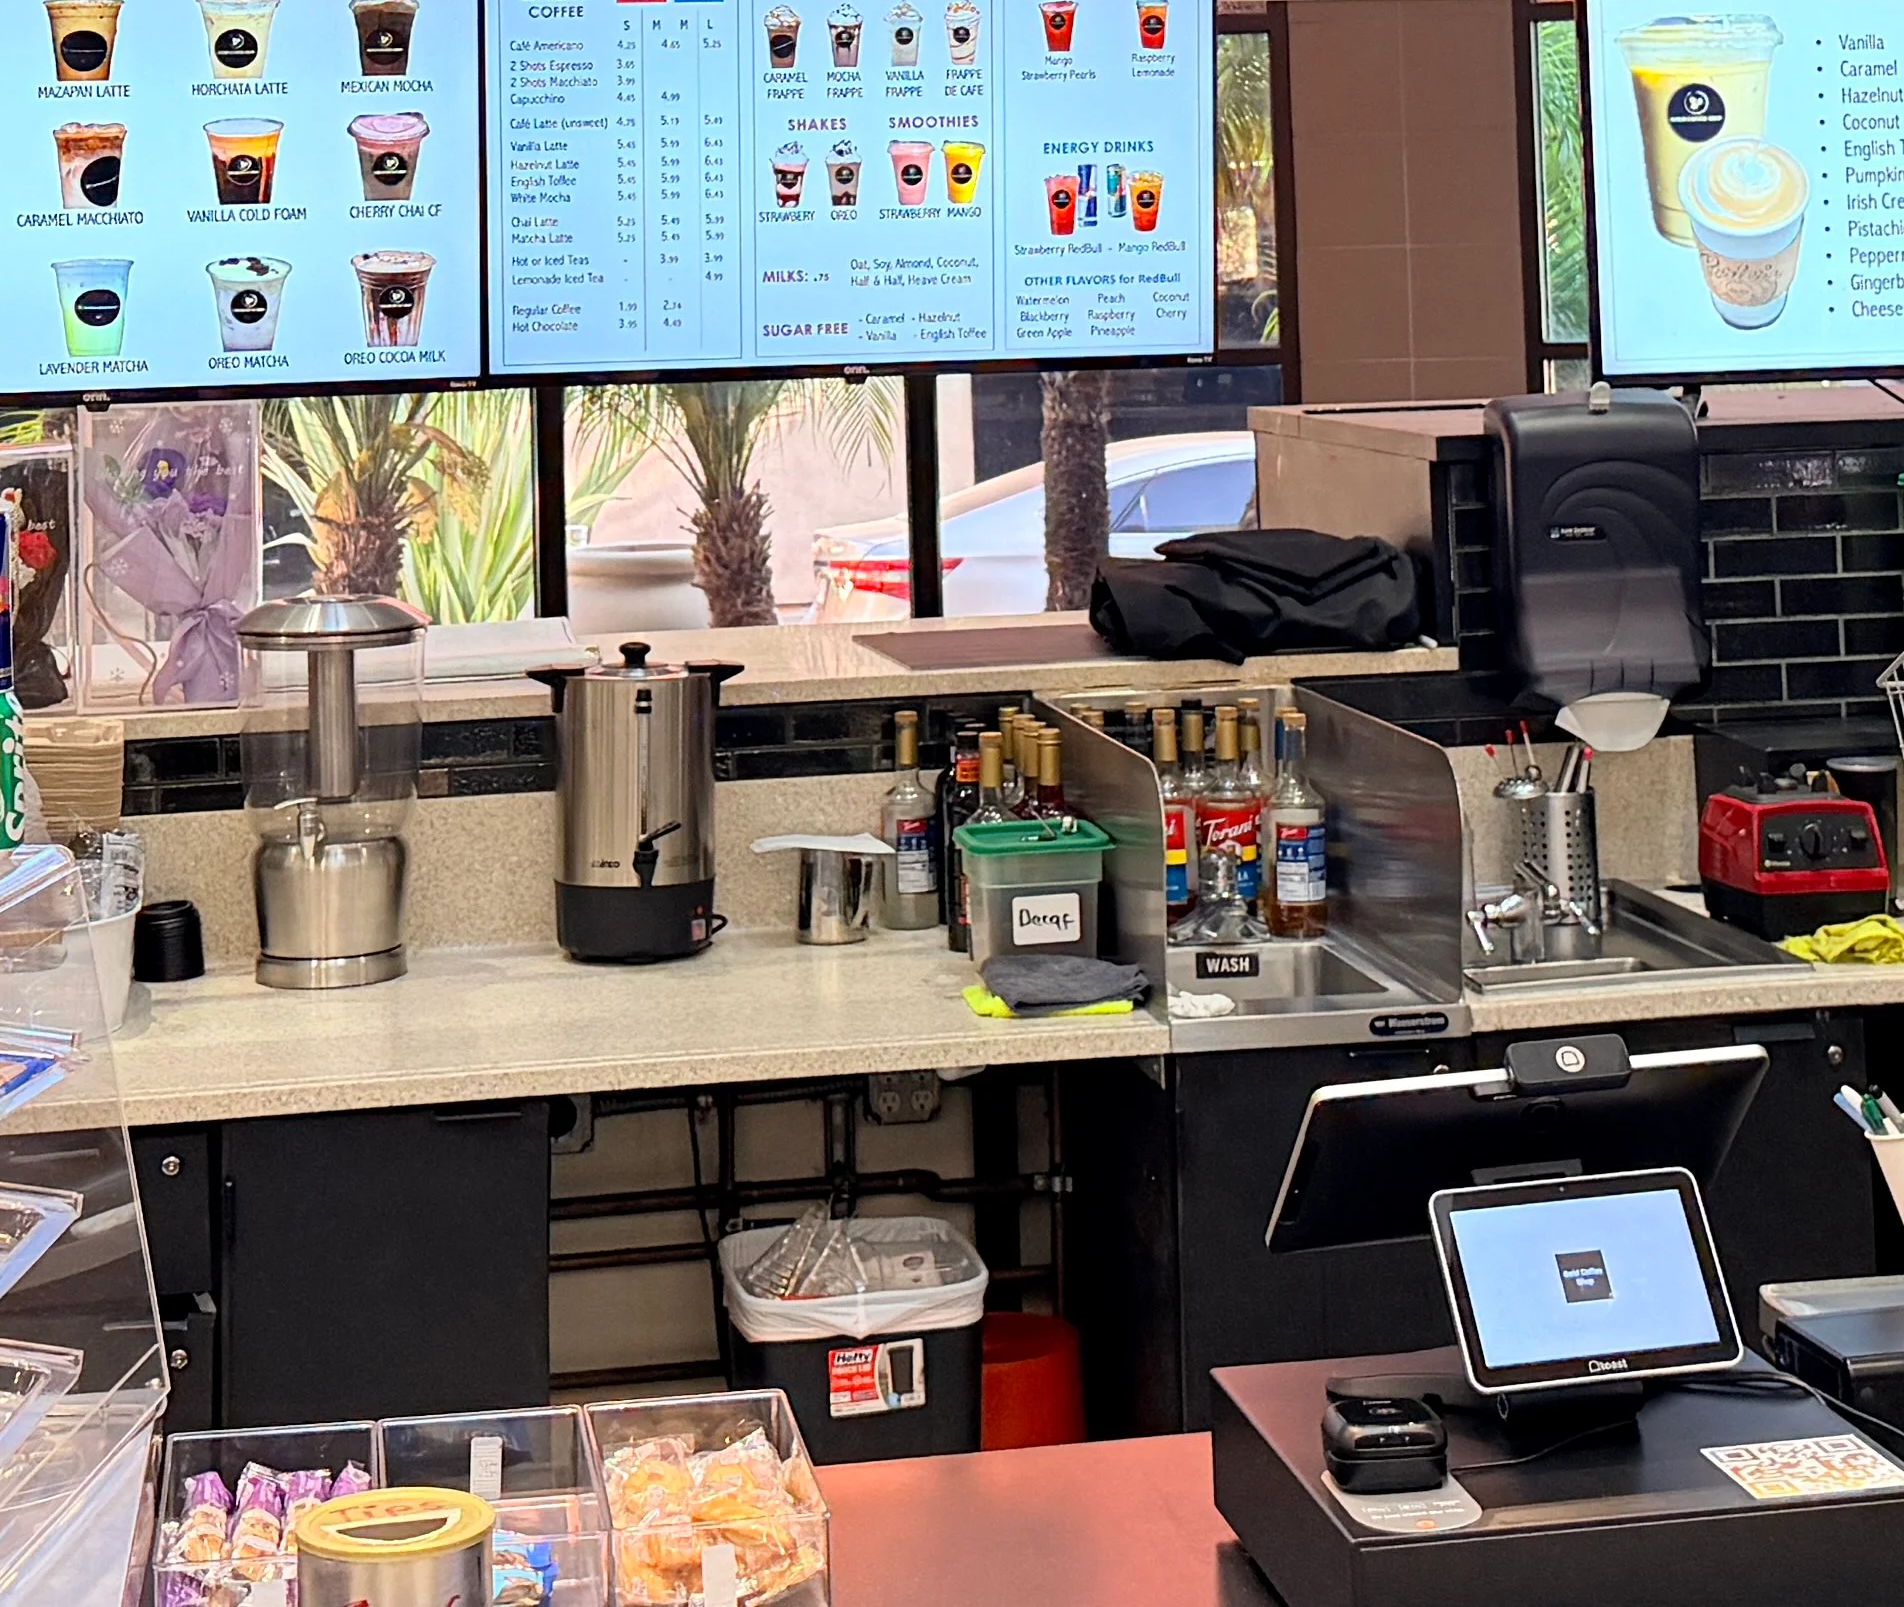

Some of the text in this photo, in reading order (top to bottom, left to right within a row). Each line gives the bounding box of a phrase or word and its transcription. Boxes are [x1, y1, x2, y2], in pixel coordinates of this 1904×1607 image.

[528, 6, 584, 19] COFFEE
[623, 21, 630, 30] S
[652, 20, 661, 30] M
[680, 20, 688, 29] M
[707, 19, 713, 29] L
[1838, 35, 1885, 50] Vanilla
[946, 69, 983, 80] FRAPPE
[1840, 60, 1898, 76] Caramel
[763, 71, 808, 83] CARAMEL
[827, 71, 861, 82] MOCHA
[885, 71, 924, 81] VANILLA
[38, 84, 130, 98] MAZAPAN LATTE
[192, 82, 288, 95] HORCHATA LATTE
[341, 80, 433, 93] MEXICAN MOCHA
[827, 87, 863, 98] FRAPPE
[886, 87, 922, 98] FRAPPE
[945, 85, 983, 96] DE CAFE
[768, 89, 804, 99] FRAPPE
[1842, 87, 1904, 104] Hazelnut
[788, 118, 847, 131] SHAKES
[888, 115, 979, 129] SMOOTHIES
[1843, 114, 1900, 130] Coconut
[1044, 141, 1154, 154] ENERGY DRINKS
[1844, 140, 1895, 160] English
[1847, 194, 1877, 210] Irish
[187, 207, 307, 222] VANILLA COLD FOAM
[350, 204, 442, 219] CHERRY CHAI CF
[831, 210, 857, 220] OREO
[879, 208, 941, 219] STRAWBERRY
[946, 207, 981, 218] MANGO
[17, 211, 144, 227] CARAMEL MACCHIATO
[762, 270, 808, 283] MILKS:
[1024, 273, 1180, 286] OTHER FLAVORS for RedBull
[1016, 295, 1069, 305] Watermelon
[1098, 294, 1125, 303] Peach
[1153, 292, 1190, 302] Coconut
[1156, 308, 1187, 319] Cherry
[1852, 301, 1904, 317] Cheese
[1021, 311, 1069, 323] Blackberry
[763, 323, 848, 336] SUGAR FREE
[208, 355, 289, 369] OREO MATCHA
[344, 350, 446, 365] OREO COCOA MILK
[39, 358, 148, 375] LAVENDER MATCHA
[1203, 814, 1254, 847] Torani
[1018, 909, 1075, 931] Decaf
[1206, 957, 1250, 973] WASH
[836, 1352, 872, 1364] Hefty
[1599, 1358, 1628, 1371] toast
